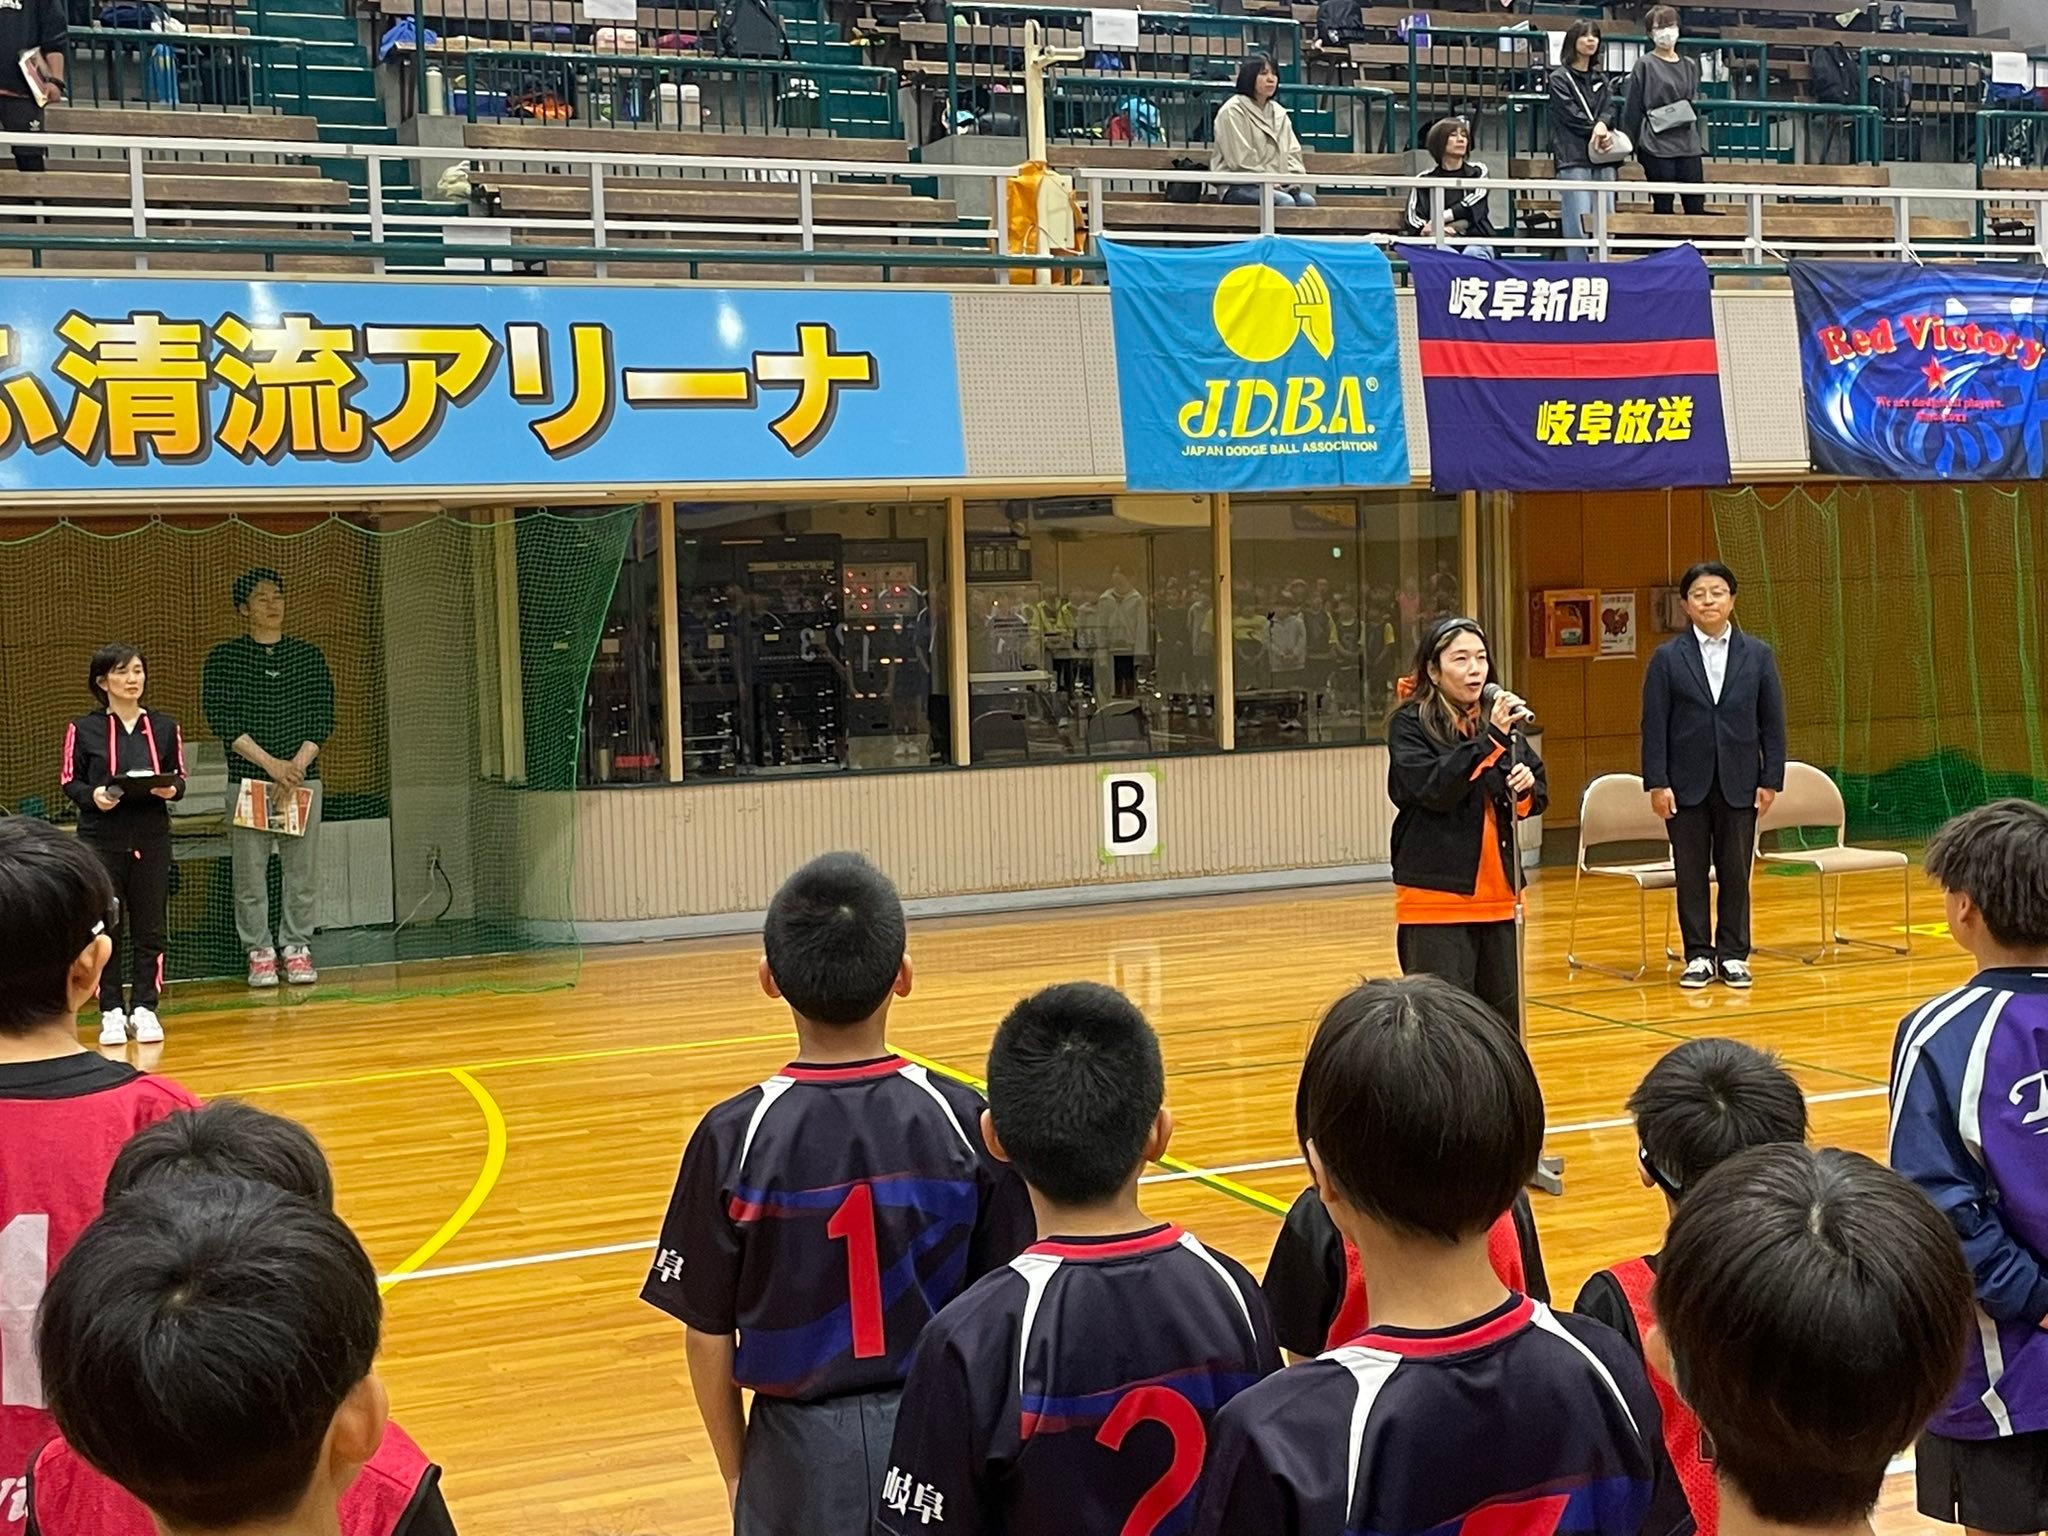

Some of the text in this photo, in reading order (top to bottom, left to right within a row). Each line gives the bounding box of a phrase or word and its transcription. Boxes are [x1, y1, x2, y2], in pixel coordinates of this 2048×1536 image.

[1448, 276, 1609, 322] 岐阜新聞
[1818, 315, 2046, 370] Red Victory
[1181, 440, 1378, 457] JAPAN DODGE BALL ASSOCIATION
[1535, 396, 1694, 445] 岐阜放送
[1111, 780, 1147, 843] B
[827, 1183, 886, 1359] 1
[1095, 1385, 1207, 1536] 2
[882, 1466, 944, 1525] 岐阜
